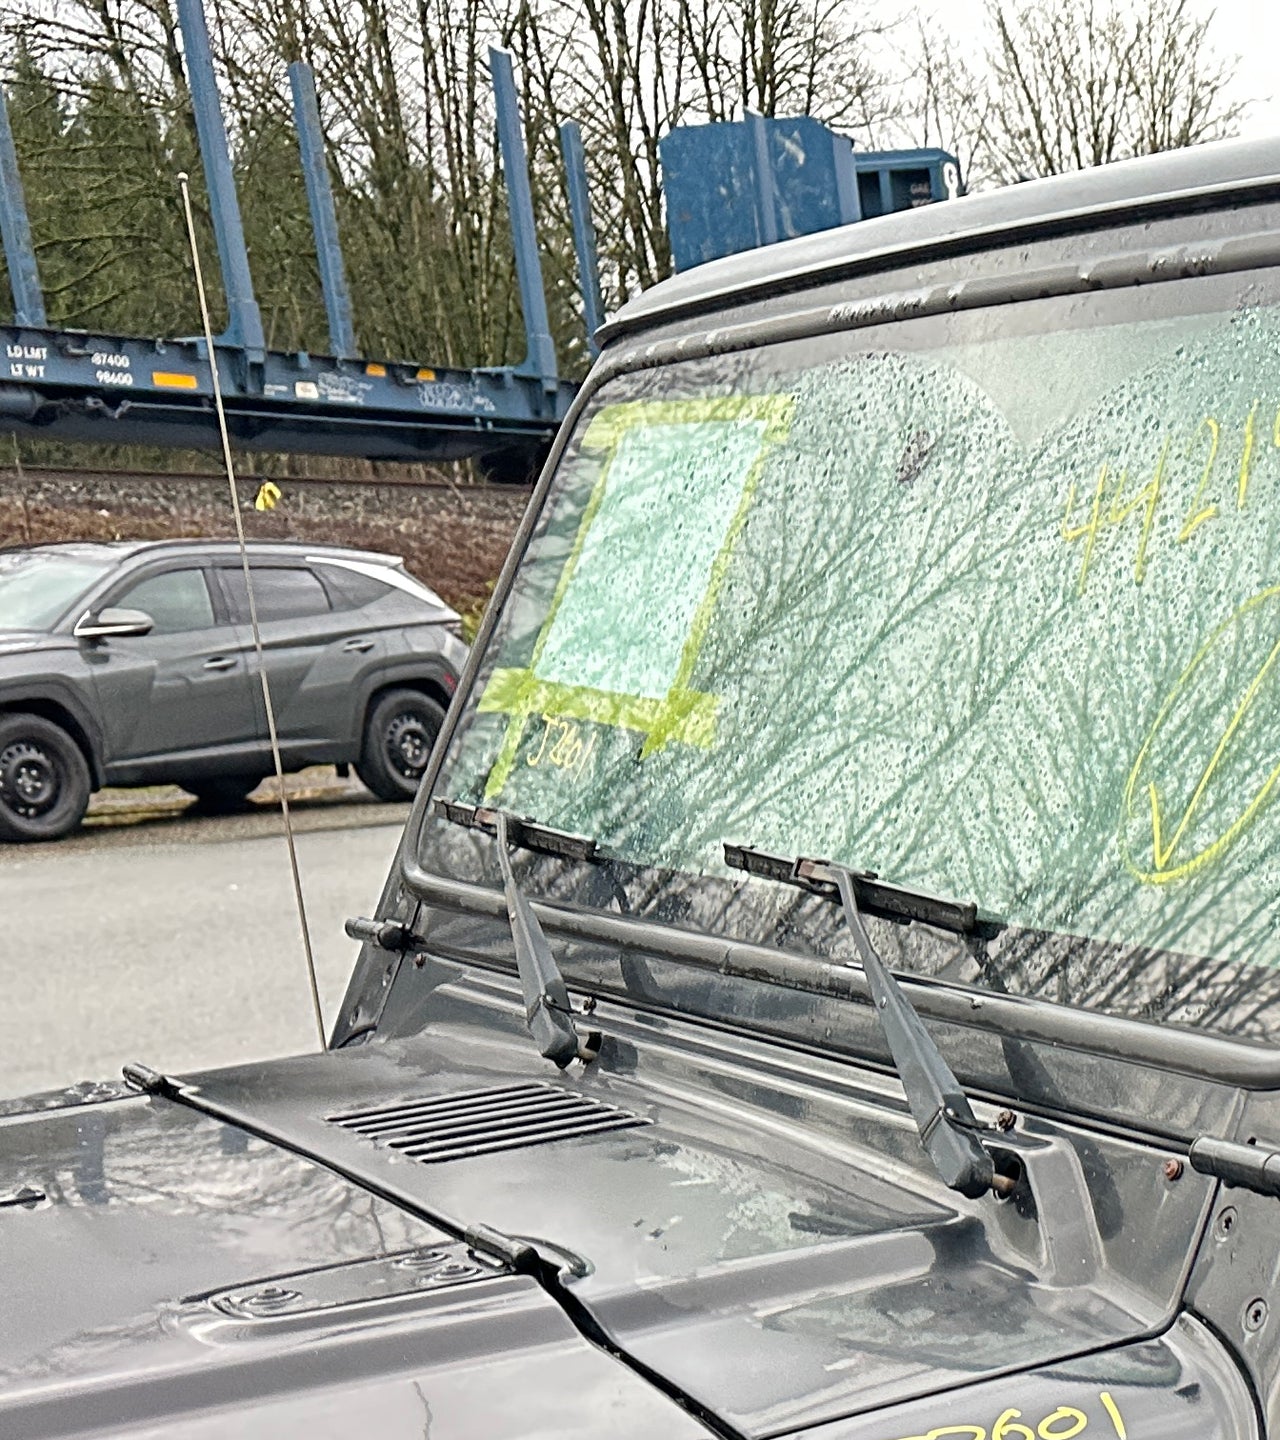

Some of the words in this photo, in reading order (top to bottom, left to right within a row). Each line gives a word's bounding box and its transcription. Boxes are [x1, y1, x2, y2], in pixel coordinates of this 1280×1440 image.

[6, 344, 23, 358] LD
[24, 346, 48, 360] LMT
[25, 364, 45, 377] WT
